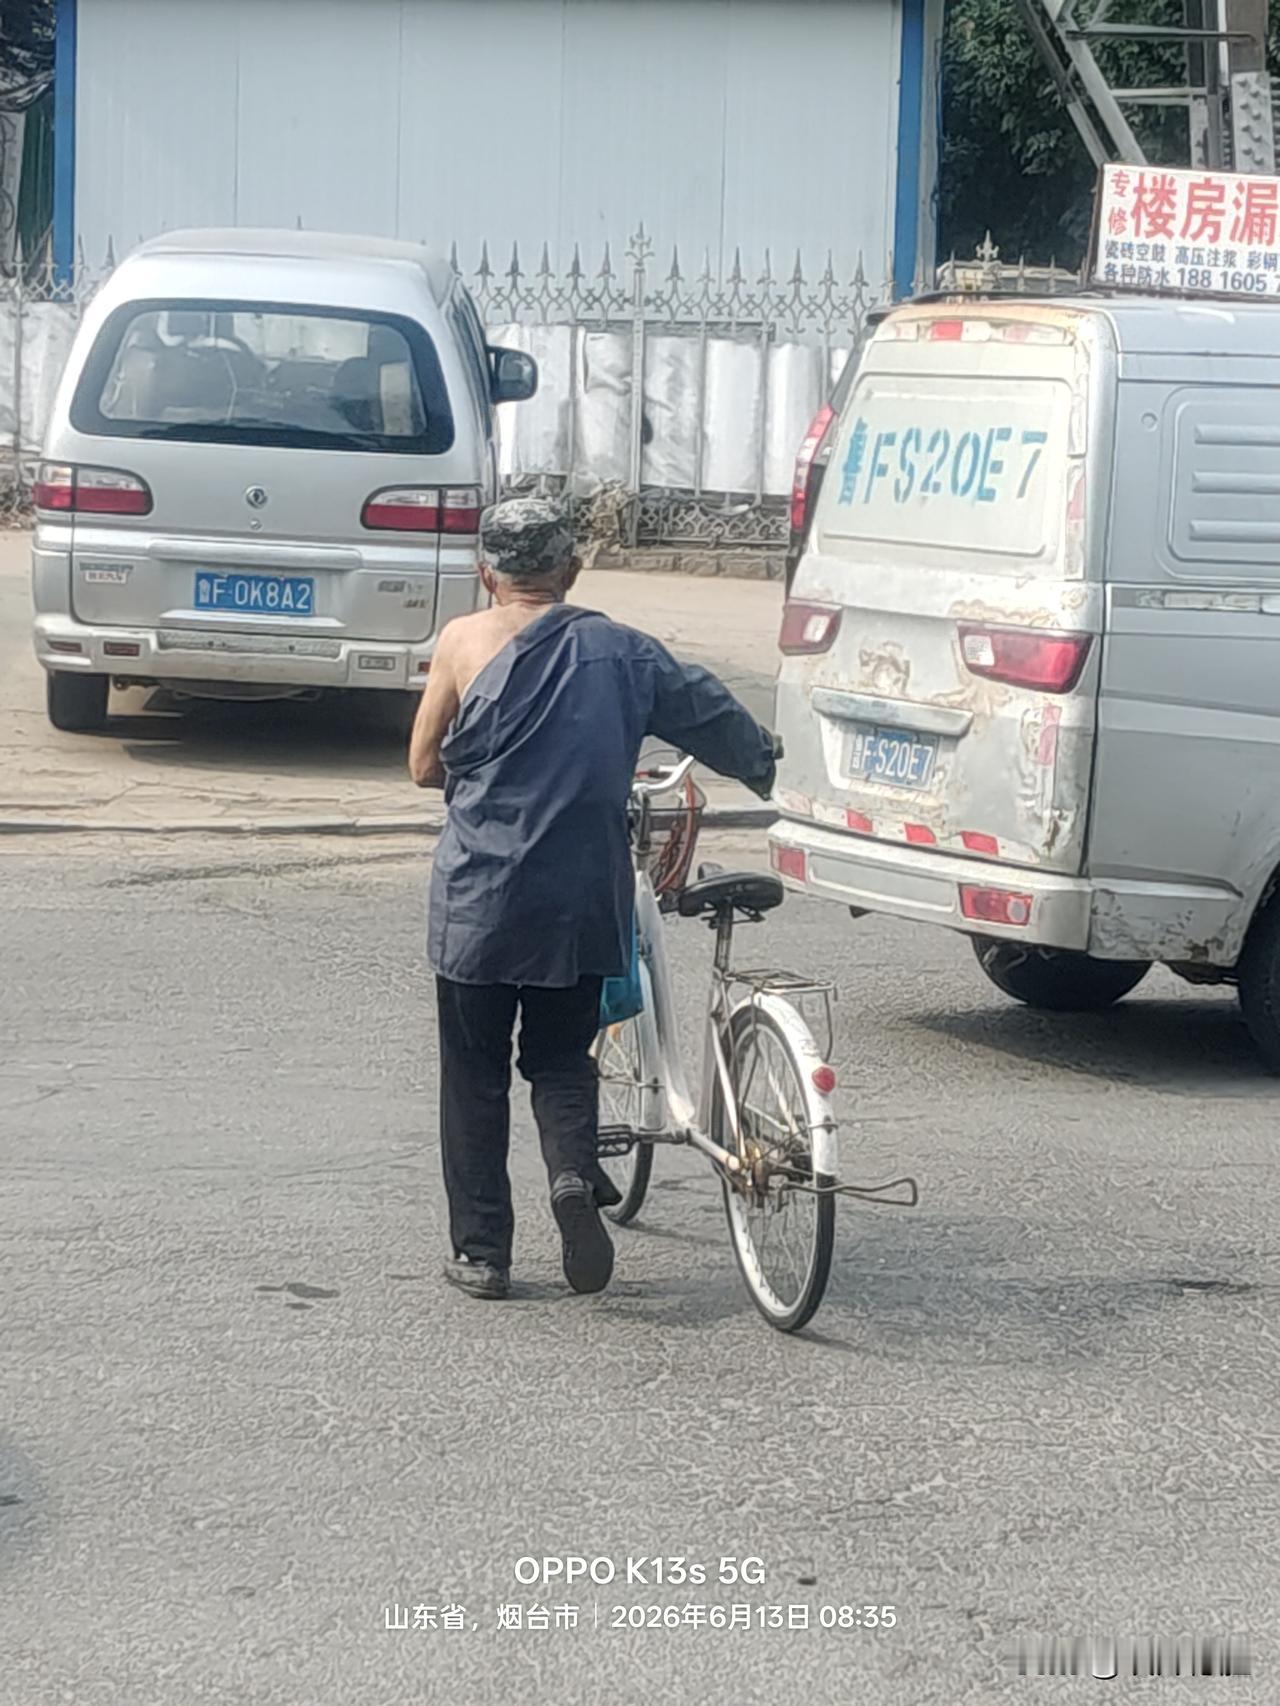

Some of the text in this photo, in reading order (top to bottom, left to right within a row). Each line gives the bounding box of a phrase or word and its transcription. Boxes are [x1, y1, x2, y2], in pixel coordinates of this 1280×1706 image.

[1131, 172, 1279, 247] 楼房漏
[1177, 267, 1212, 288] 188
[1219, 270, 1268, 292] 1605
